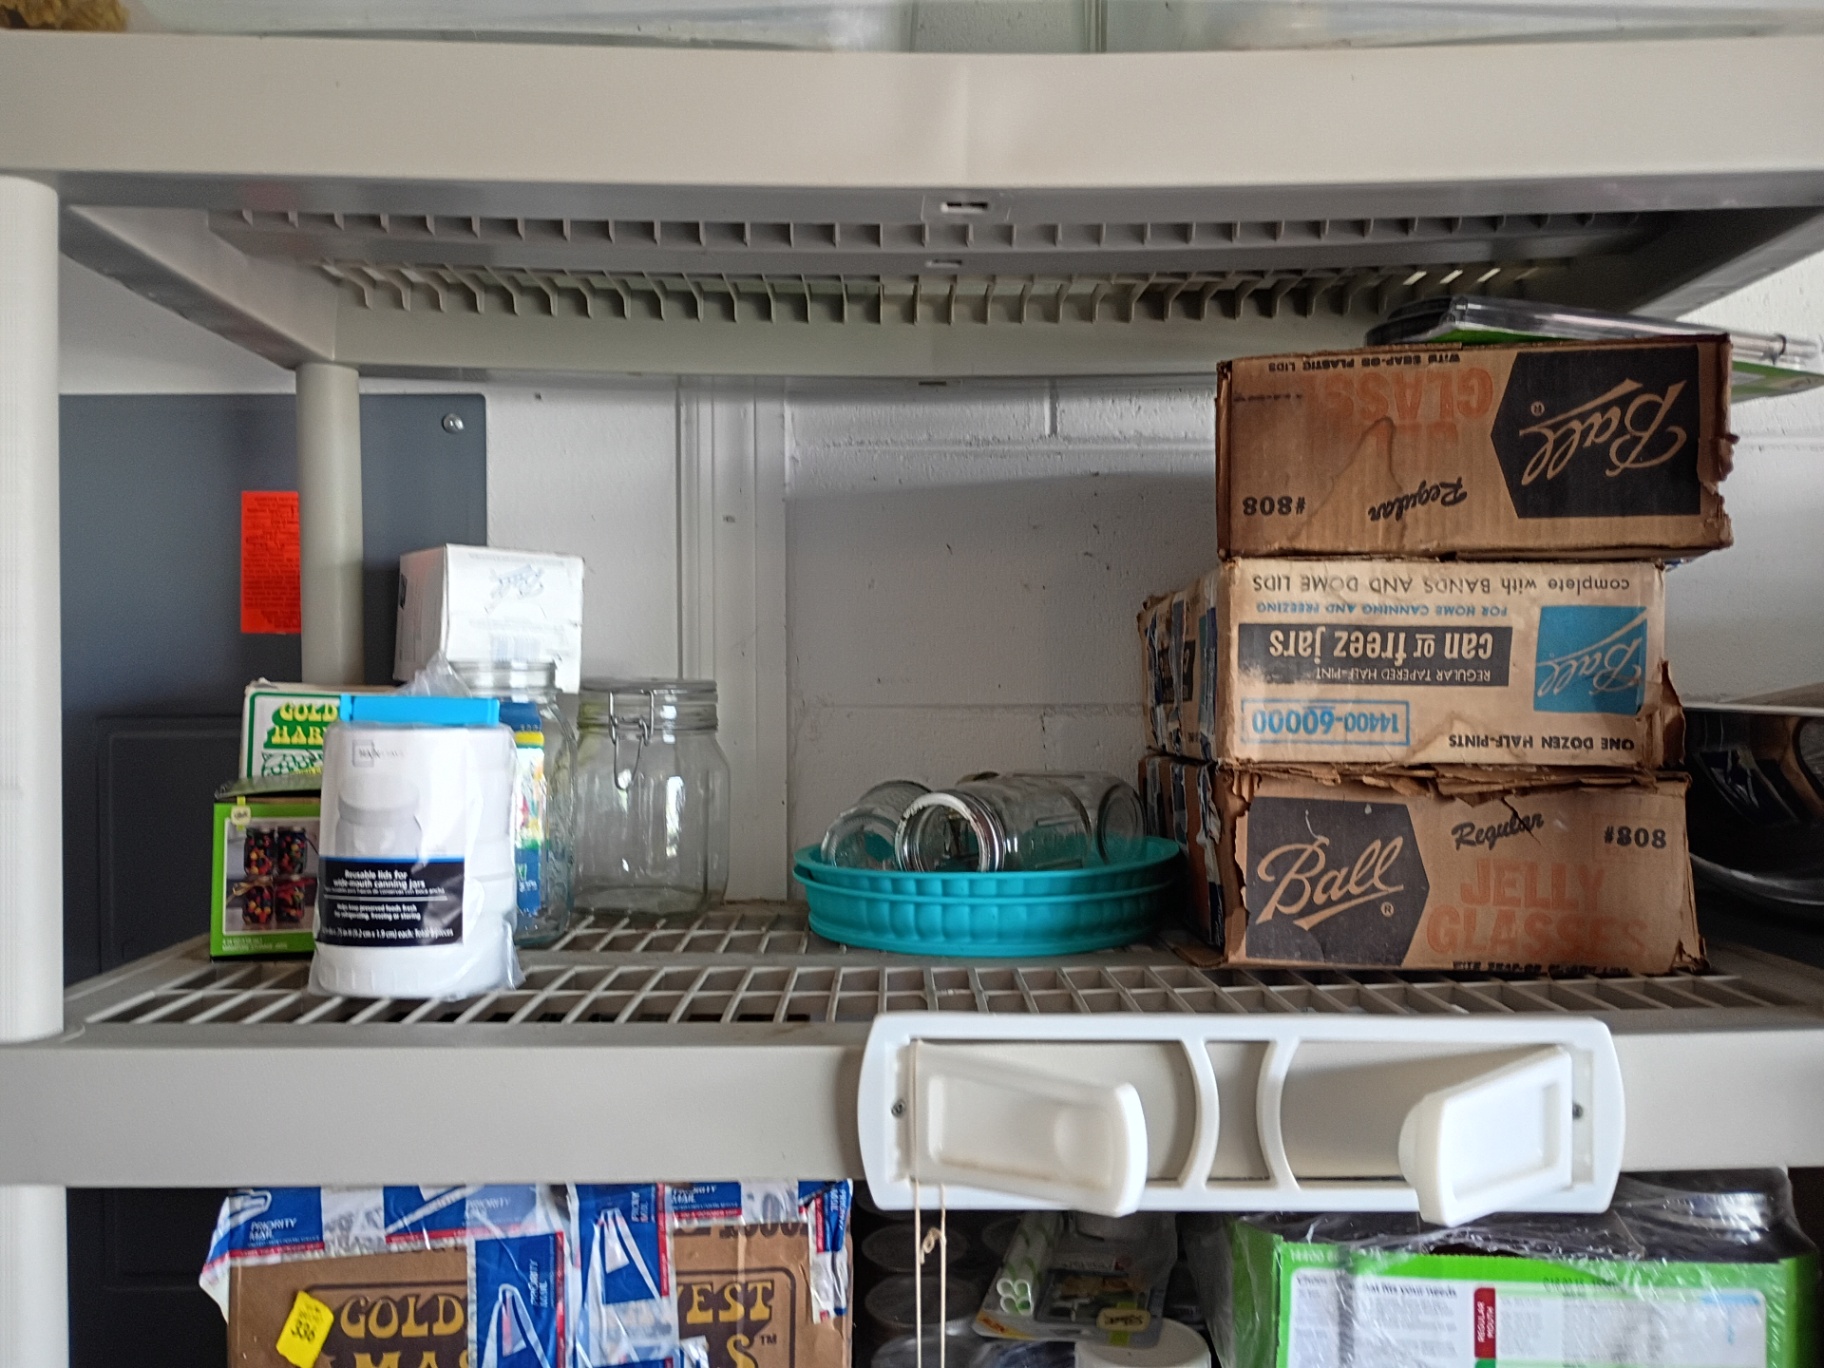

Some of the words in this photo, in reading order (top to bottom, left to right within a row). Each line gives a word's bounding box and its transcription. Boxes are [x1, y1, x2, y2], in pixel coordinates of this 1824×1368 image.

[1268, 361, 1296, 372] LIDS
[1303, 358, 1354, 371] PLASTIC
[1519, 379, 1687, 486] Ball
[1242, 496, 1306, 515] #808
[1368, 476, 1467, 521] Regular
[1253, 574, 1290, 592] LIDS
[1302, 575, 1358, 593] DOME
[1369, 576, 1413, 594] AND
[1425, 577, 1490, 594] BANDS
[1502, 578, 1537, 595] with
[1548, 576, 1630, 595] complete
[1256, 601, 1320, 613] FREEZING
[1326, 602, 1356, 613] AND
[1362, 603, 1429, 615] CANNING
[1435, 604, 1475, 616] HOME
[1481, 605, 1508, 616] FOR
[1269, 626, 1326, 664] jars
[1333, 631, 1407, 666] freez
[1413, 637, 1435, 659] or
[1444, 632, 1493, 659] can
[1382, 668, 1431, 681] TAPERED
[1436, 668, 1490, 681] REGULAR
[1537, 633, 1643, 698] Ball
[279, 702, 339, 722] GOLD
[1252, 708, 1400, 735] 14400-60000
[1448, 734, 1533, 749] HALF-PINTS
[1541, 736, 1594, 750] DOZEN
[1601, 737, 1635, 750] ONE
[1451, 813, 1544, 850] Regular
[1604, 825, 1667, 849] #808
[394, 869, 408, 880] for
[1256, 836, 1404, 930] Ball
[374, 880, 407, 890] canning
[409, 880, 425, 890] jars
[1460, 858, 1605, 911] JELLY
[1427, 904, 1649, 960] GLASSES
[677, 1281, 773, 1324] EST
[341, 1294, 465, 1339] GOLD
